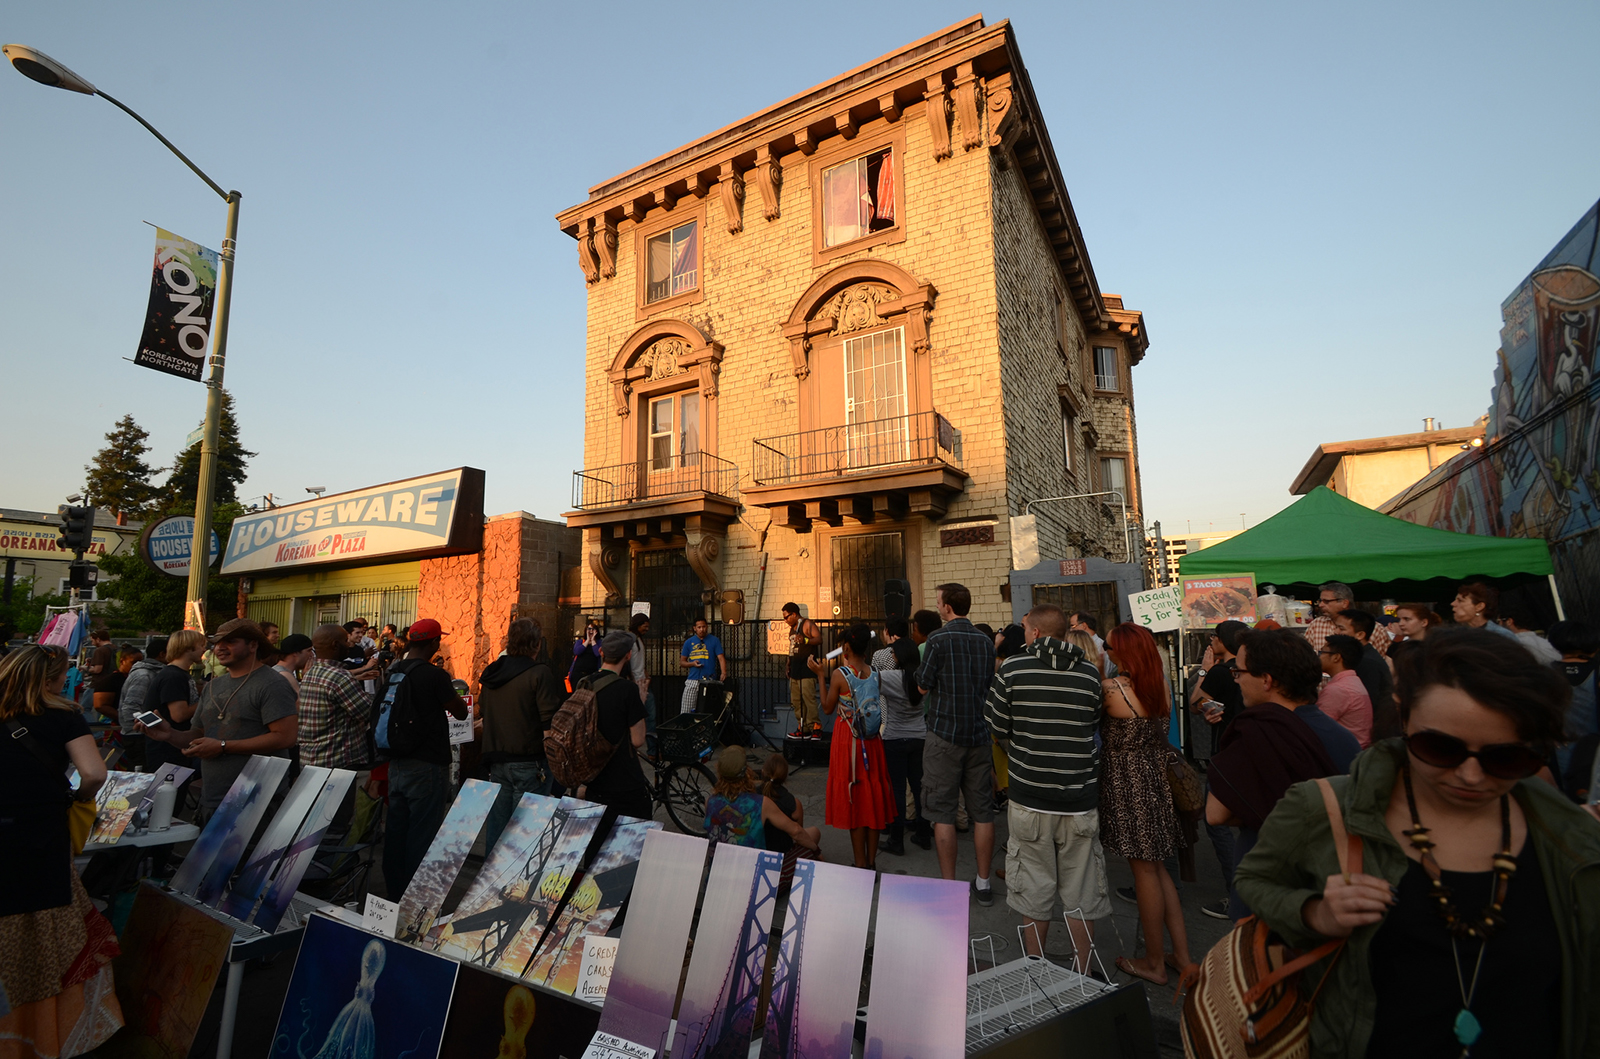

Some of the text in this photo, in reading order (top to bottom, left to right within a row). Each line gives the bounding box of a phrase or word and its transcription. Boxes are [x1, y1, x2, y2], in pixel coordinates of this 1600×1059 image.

[140, 354, 198, 376] NORTHGATE
[142, 348, 199, 370] KOREATOWN
[232, 486, 443, 558] HOUSEWARE
[0, 535, 57, 552] OREANA
[330, 533, 366, 555] PLAZA
[943, 527, 991, 545] 2338
[275, 543, 317, 563] KOREANA
[163, 561, 188, 570] KOREANA
[1141, 614, 1152, 625] 3
[1155, 610, 1171, 621] for
[772, 632, 789, 642] COME
[581, 980, 607, 996] ACCEPTE
